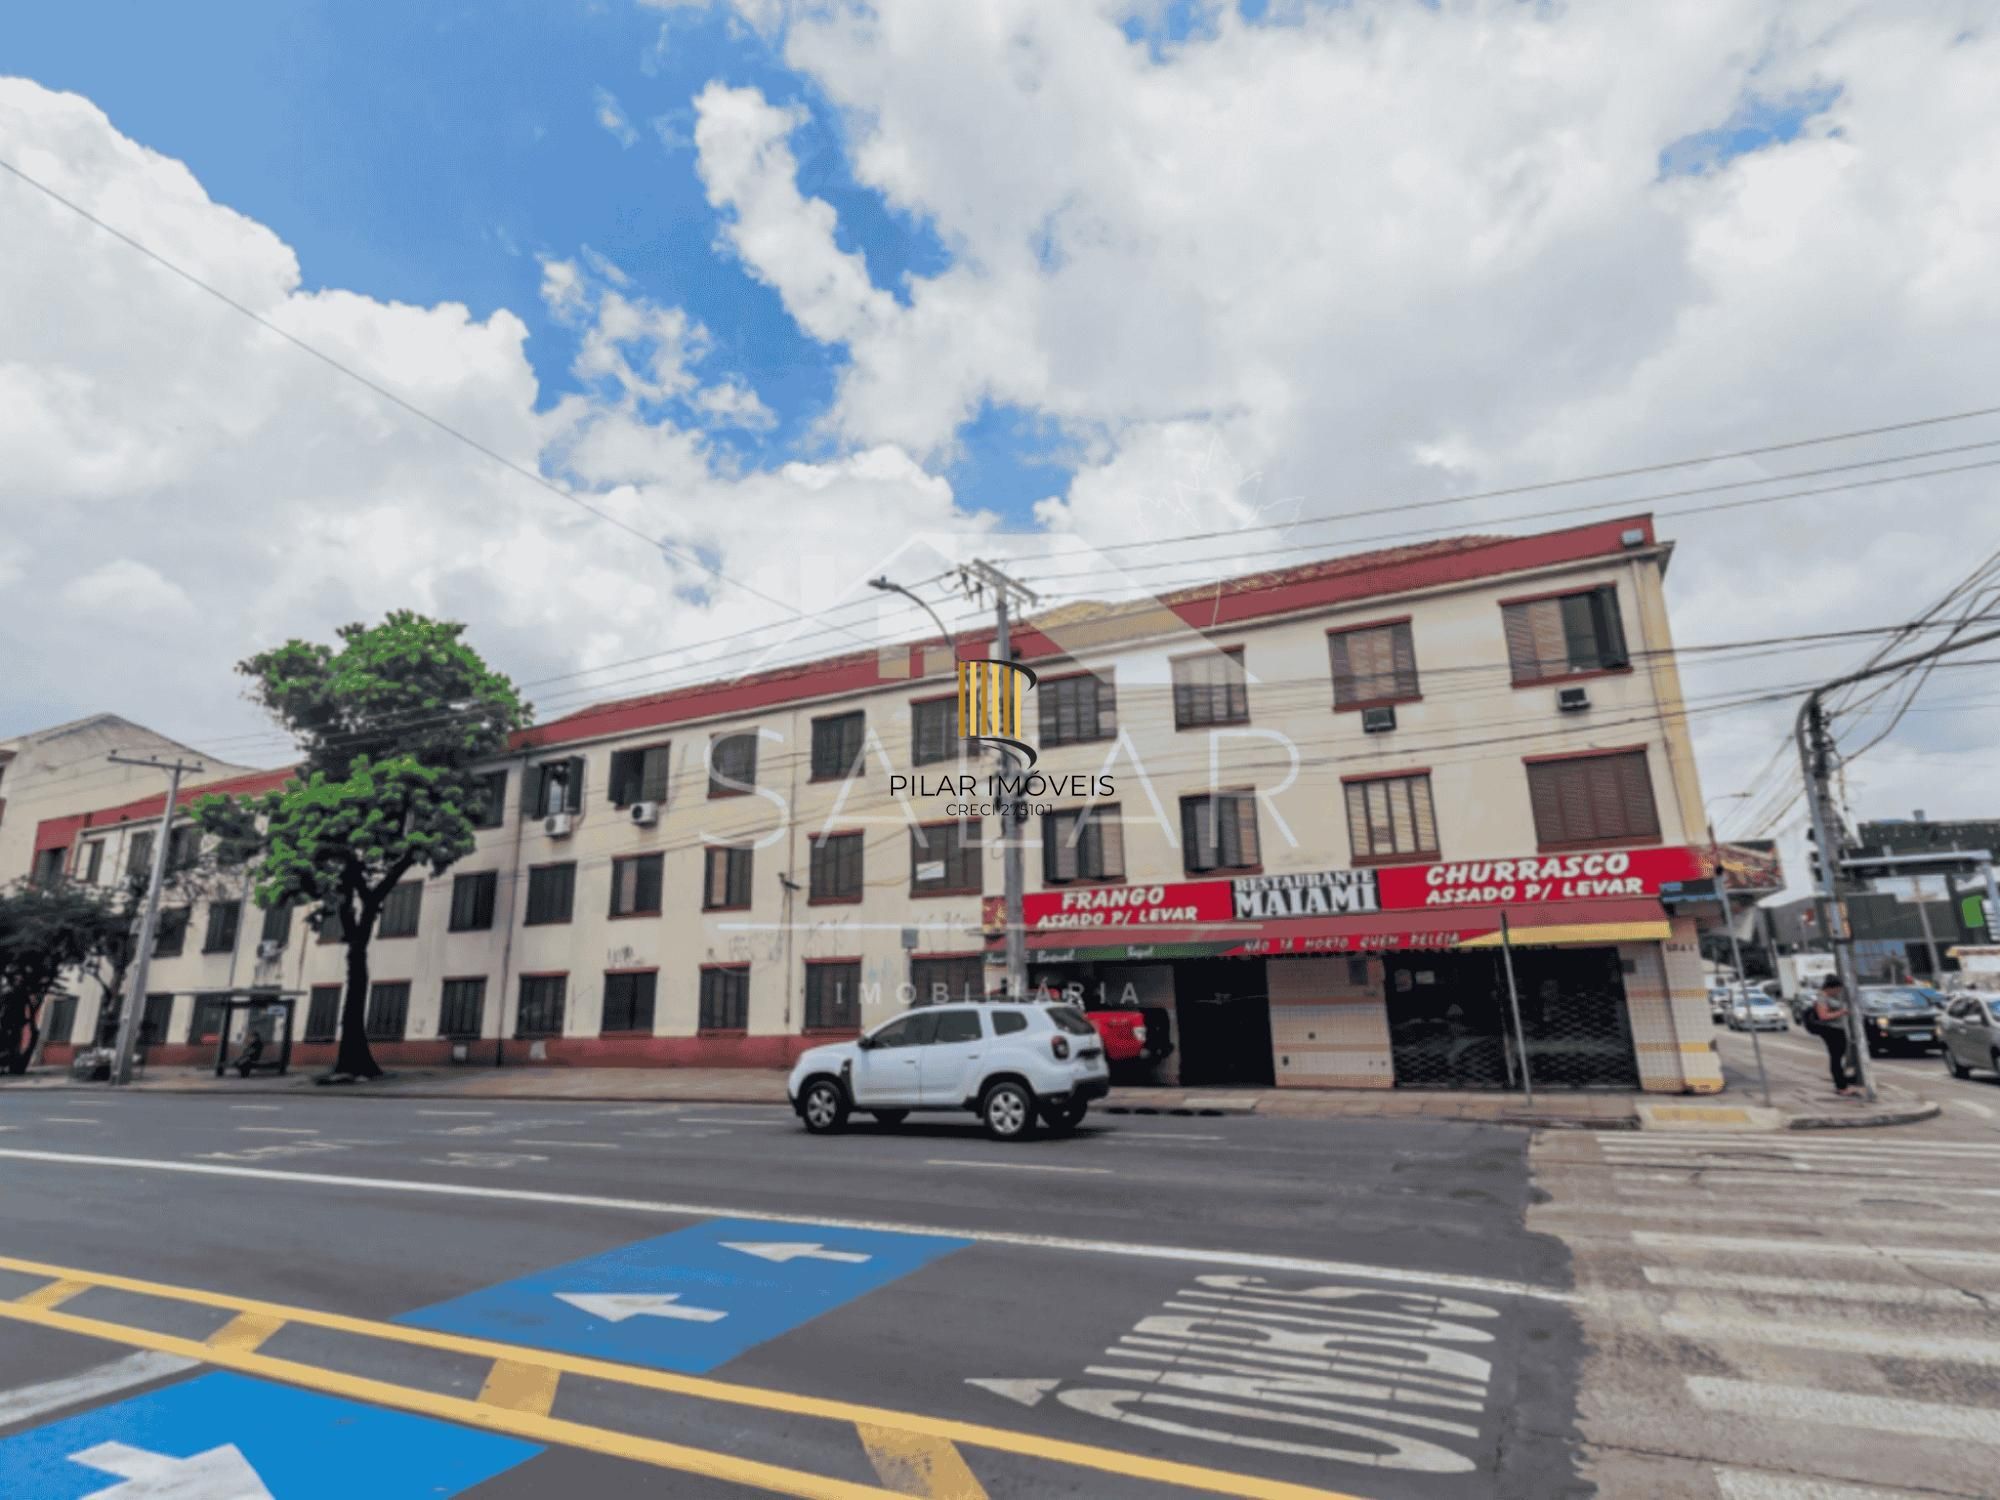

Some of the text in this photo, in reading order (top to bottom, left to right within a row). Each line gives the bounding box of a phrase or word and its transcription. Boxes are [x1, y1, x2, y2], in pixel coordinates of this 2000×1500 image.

[1235, 870, 1373, 890] RESTAURANTE
[1426, 853, 1629, 886] CHURRASCO
[1061, 886, 1165, 910] FRANGO
[1426, 877, 1644, 904] ASSADO P/ LEVAR
[1037, 906, 1198, 929] ASSADO P/ LEVAR
